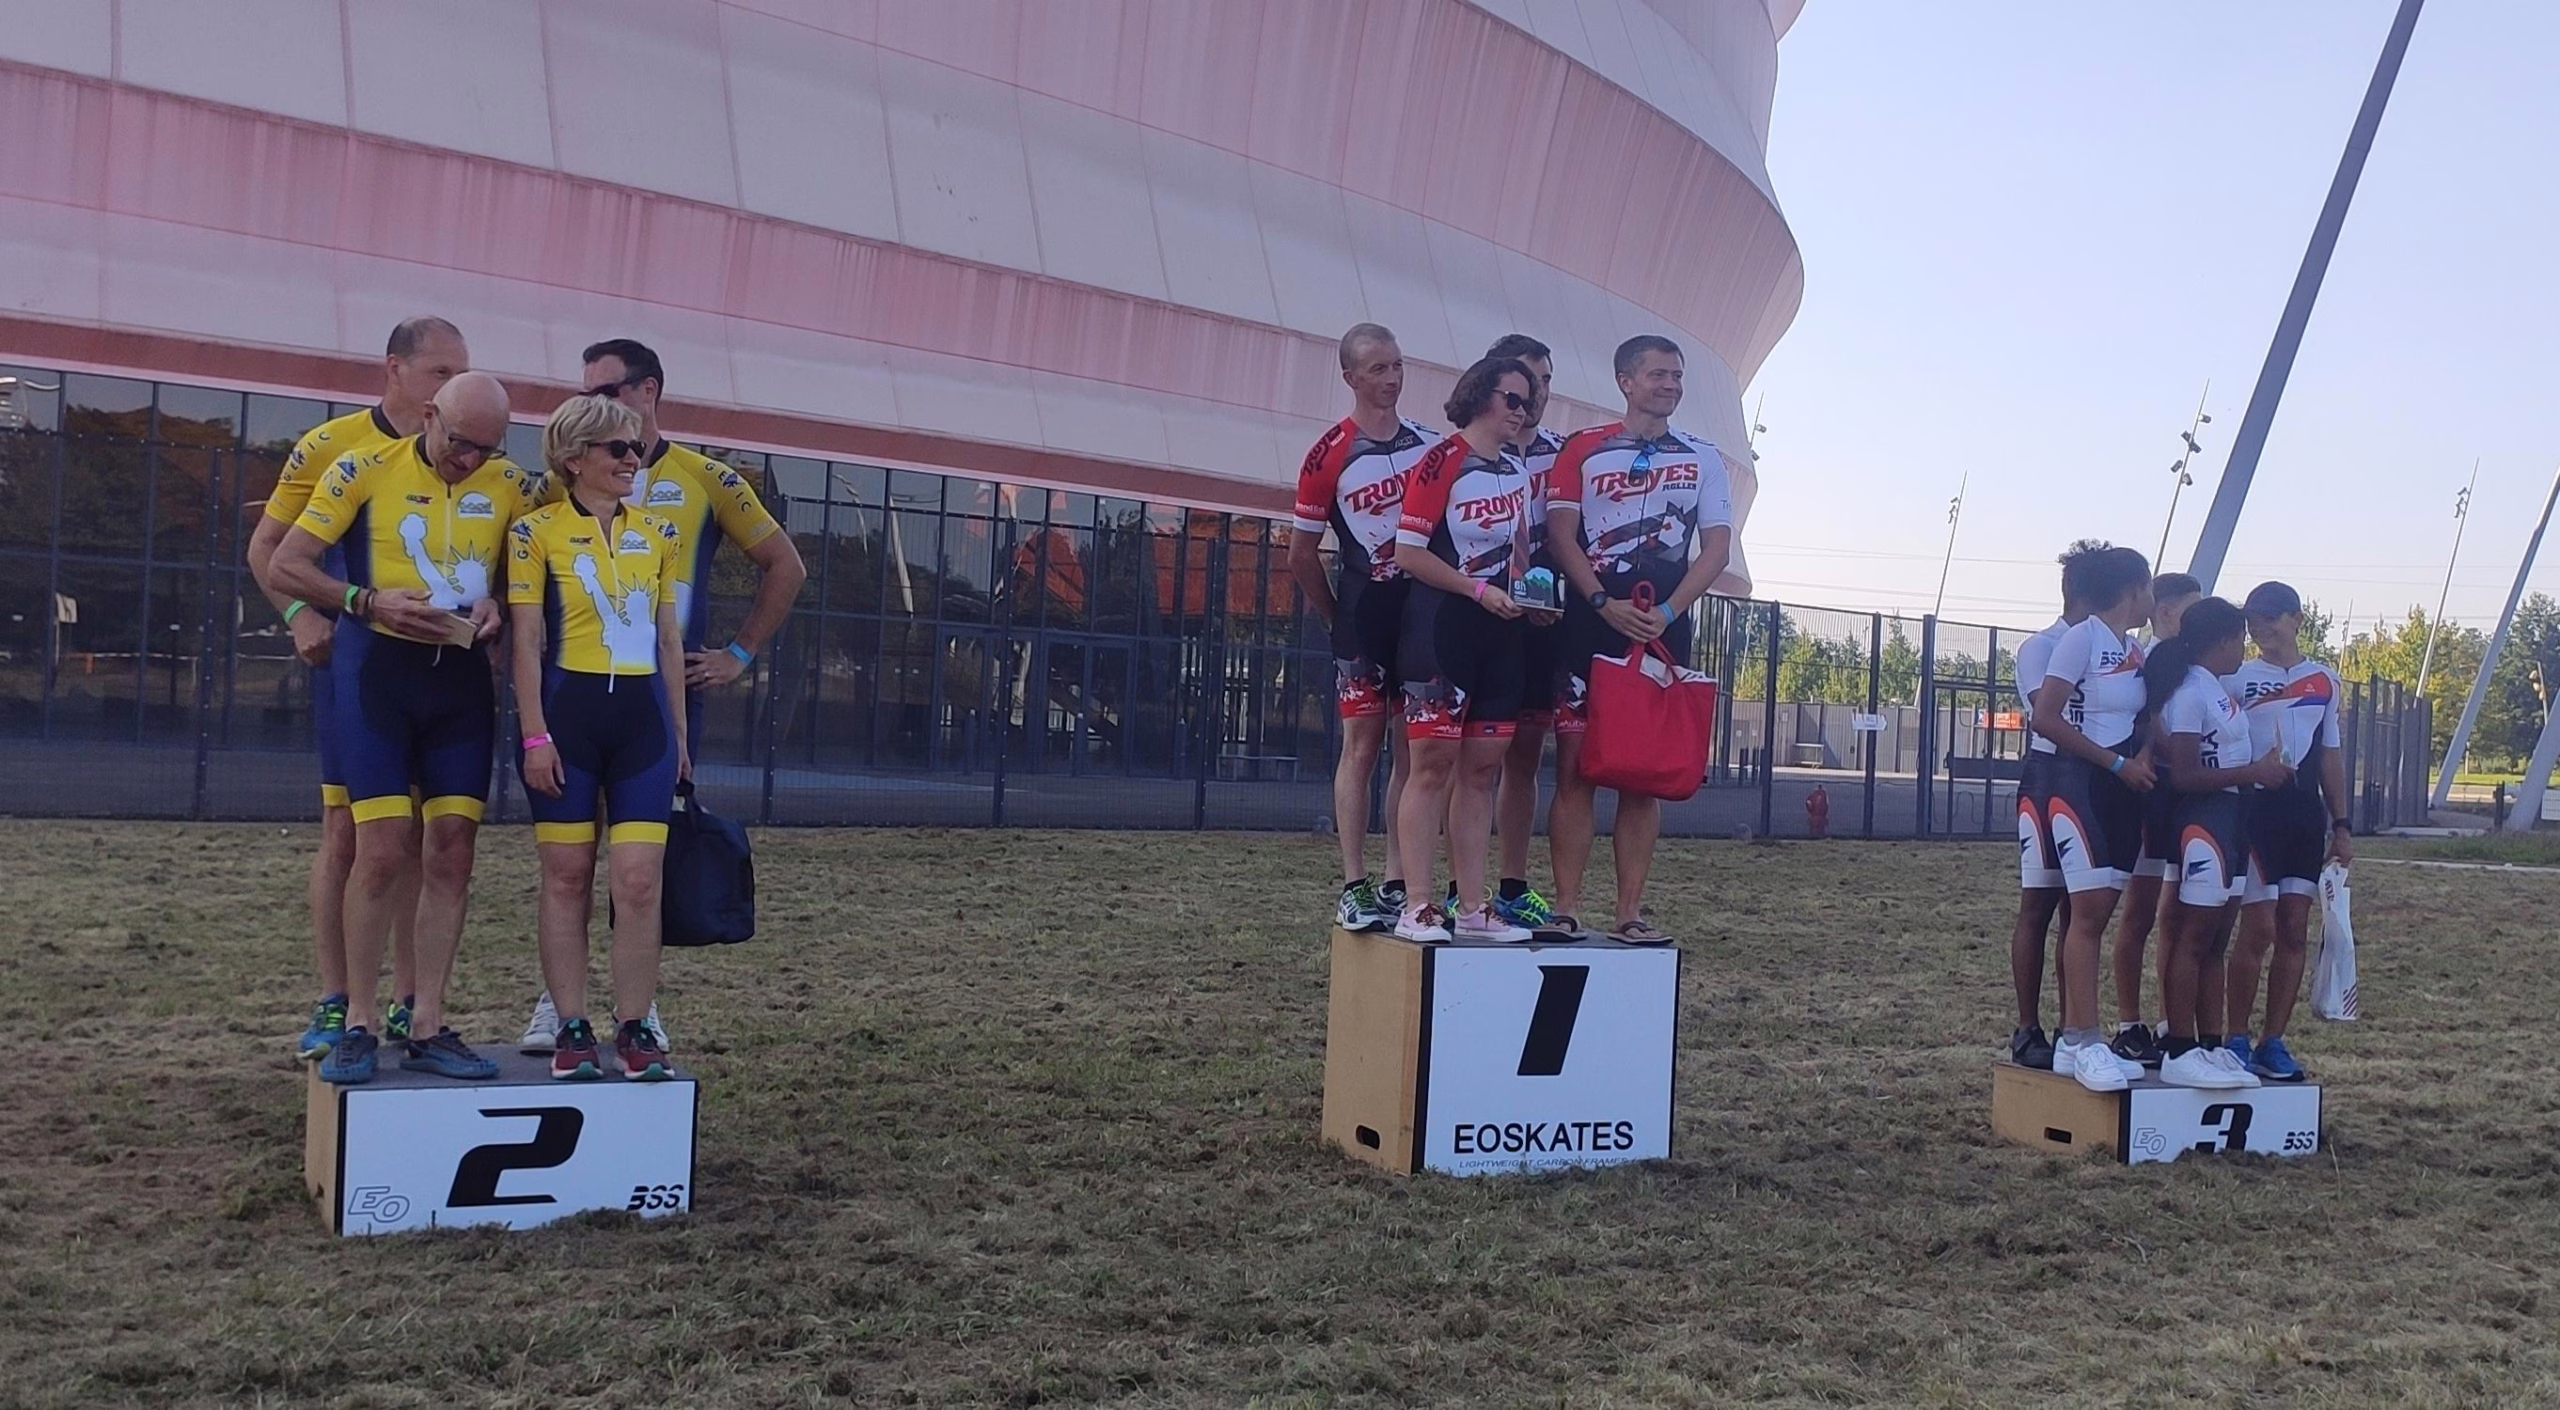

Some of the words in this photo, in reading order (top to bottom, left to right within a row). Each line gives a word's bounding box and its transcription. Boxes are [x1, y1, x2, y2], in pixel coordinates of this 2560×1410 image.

[1344, 467, 1414, 516] TROY
[2244, 681, 2285, 699] BSS
[1454, 1120, 1634, 1154] EOSKATES
[2133, 1127, 2167, 1155] EO
[2195, 1103, 2253, 1154] 3
[2283, 1131, 2316, 1151] BSS
[446, 1106, 584, 1208] 2
[348, 1186, 410, 1223] EO
[626, 1184, 684, 1211] BSS
